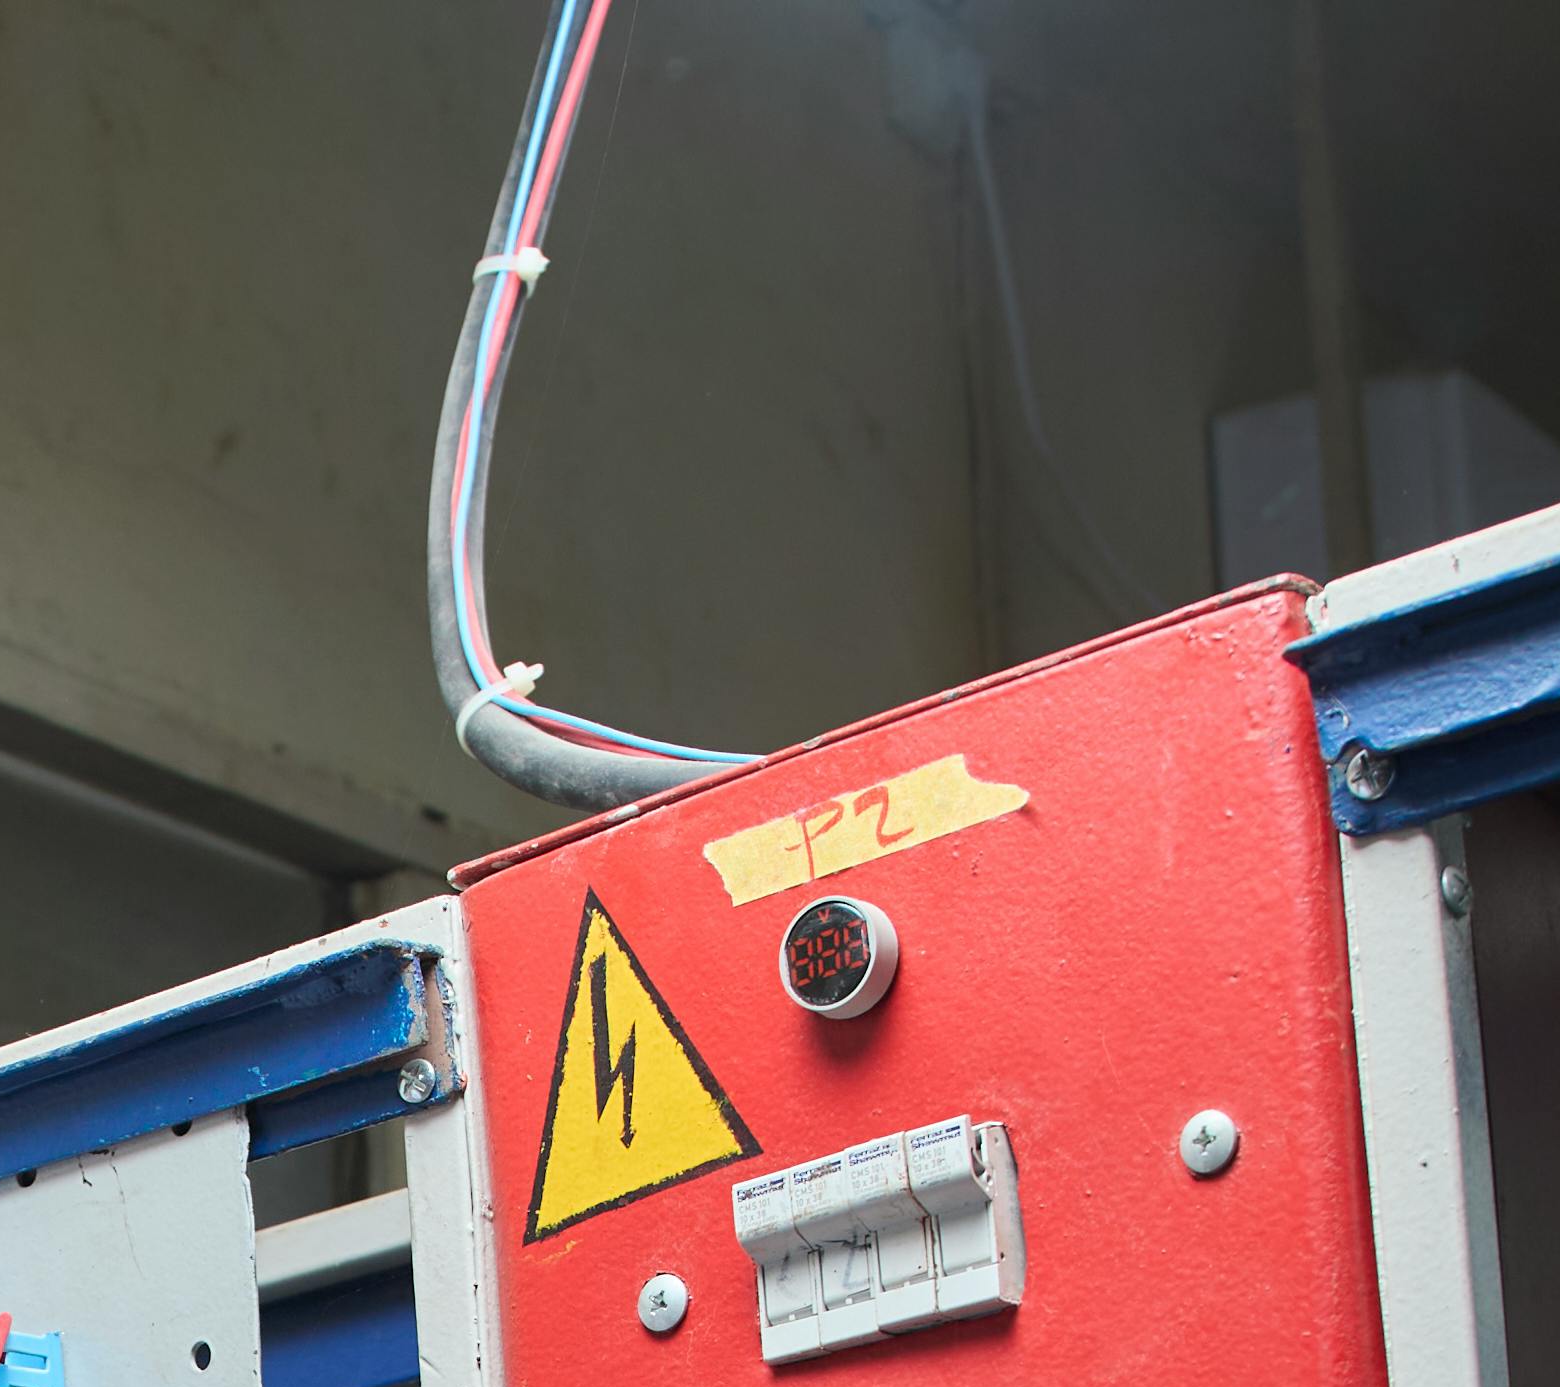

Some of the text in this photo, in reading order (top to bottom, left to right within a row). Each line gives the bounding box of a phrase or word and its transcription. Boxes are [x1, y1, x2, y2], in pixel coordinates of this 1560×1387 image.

[784, 784, 916, 881] P2
[817, 907, 831, 924] V
[910, 1129, 943, 1145] Ferraz
[911, 1130, 961, 1152] Shawmut
